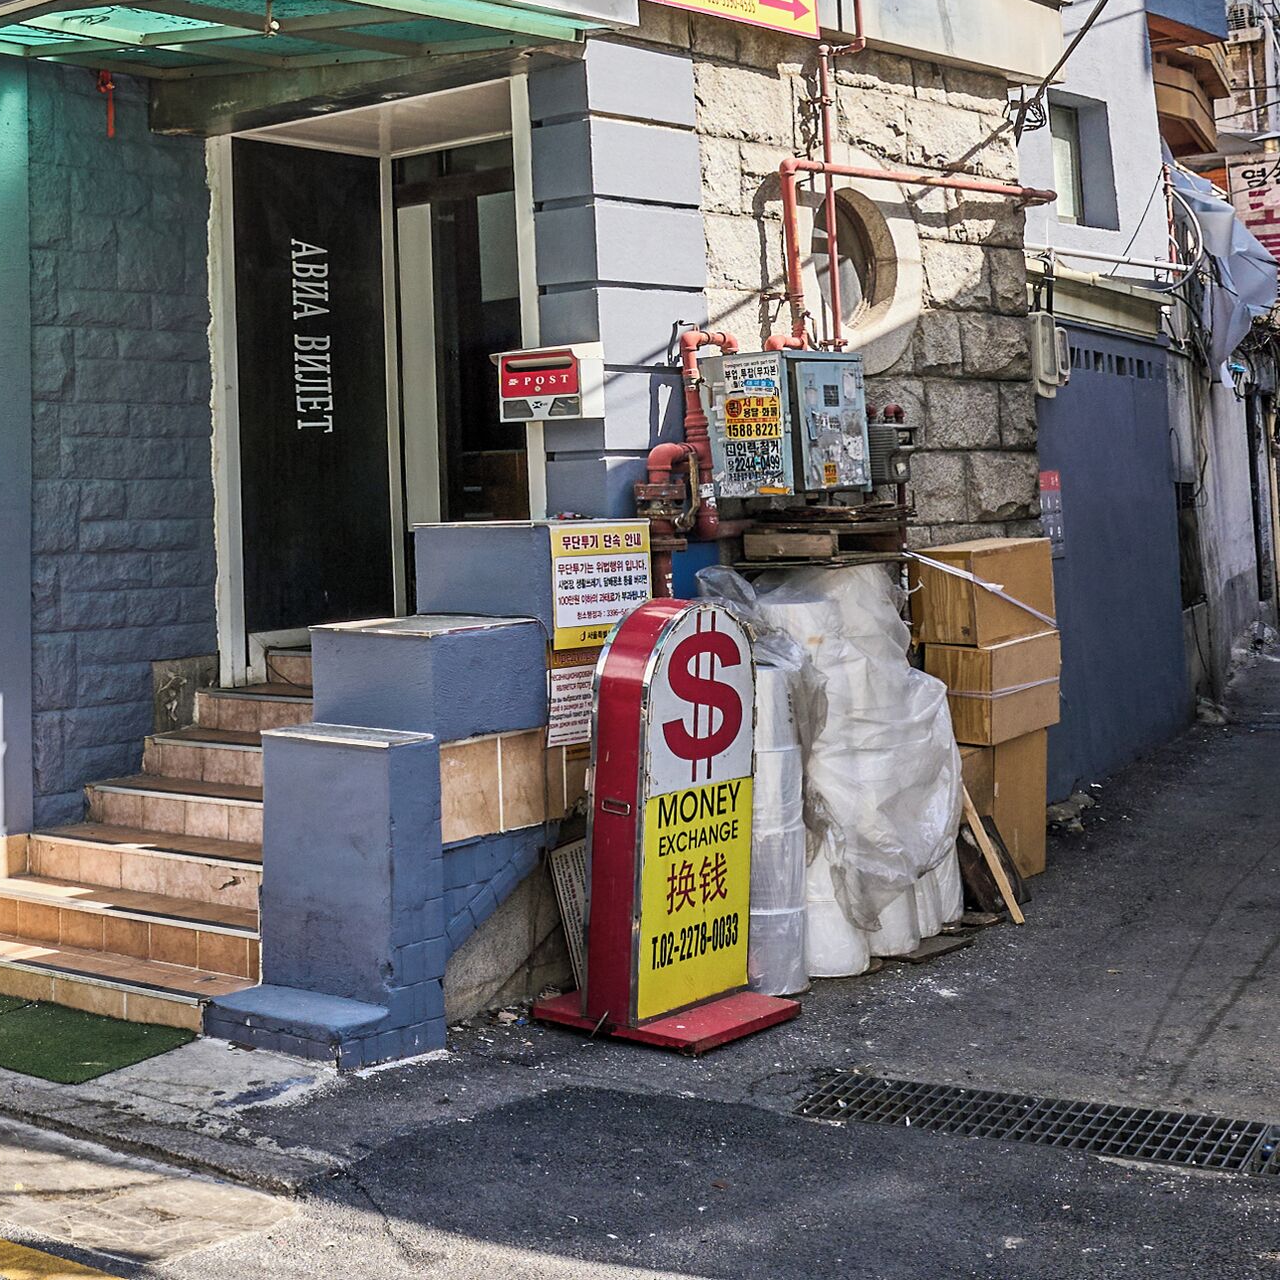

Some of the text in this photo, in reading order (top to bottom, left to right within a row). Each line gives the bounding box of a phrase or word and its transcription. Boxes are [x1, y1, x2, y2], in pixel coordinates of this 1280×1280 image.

[524, 374, 569, 386] POST
[562, 533, 642, 550] 무단투기 단속 안내
[558, 562, 594, 576] 무단투기는
[596, 560, 623, 573] 위법행위
[657, 780, 742, 829] MONEY
[658, 819, 739, 858] EXCHANGE
[666, 852, 729, 916] 换钱
[651, 912, 739, 971] T.02-2278-0033
